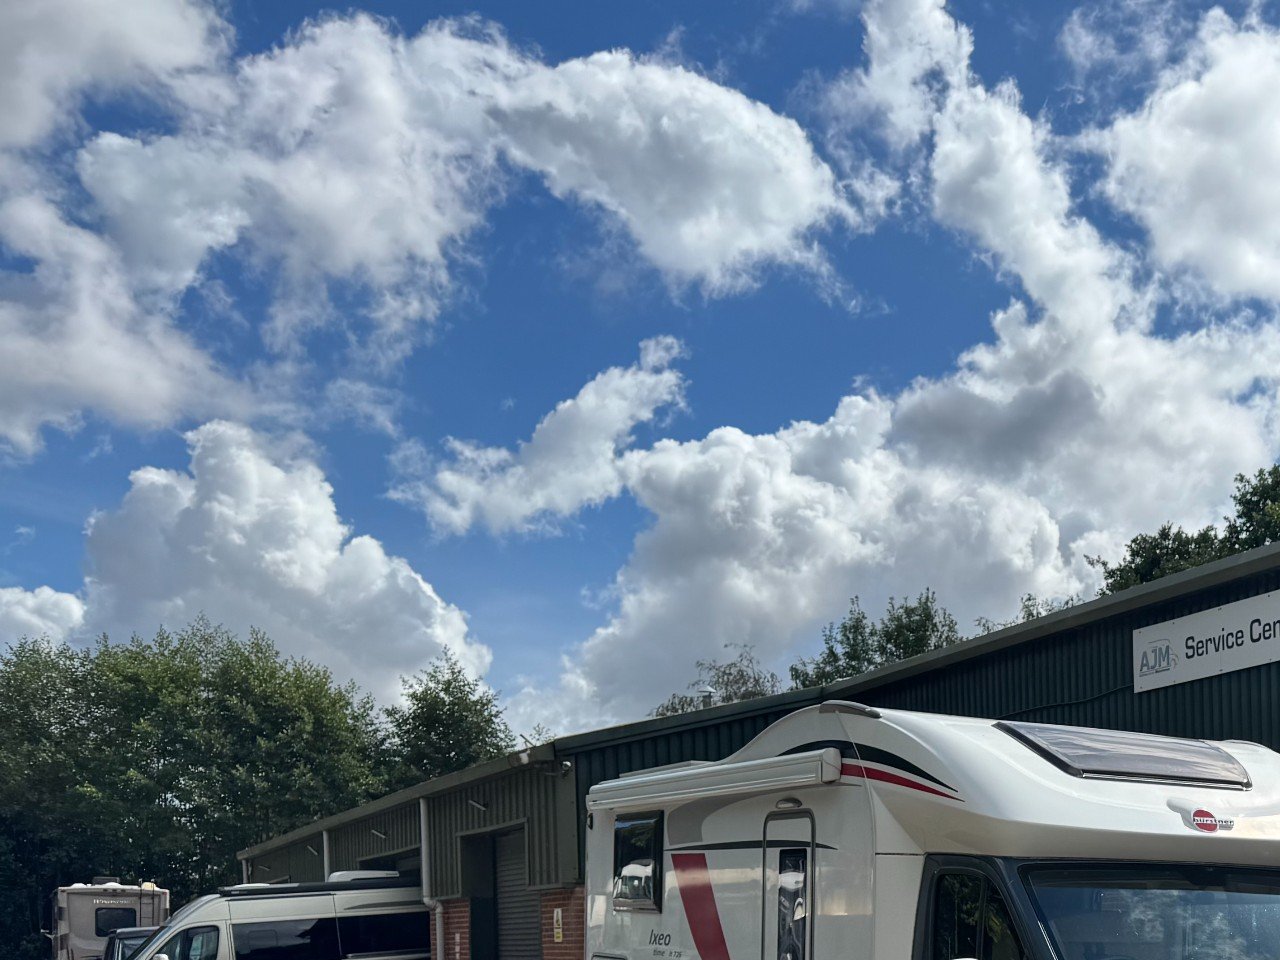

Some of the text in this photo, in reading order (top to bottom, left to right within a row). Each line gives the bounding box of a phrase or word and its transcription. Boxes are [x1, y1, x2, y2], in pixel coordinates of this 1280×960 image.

[1185, 628, 1244, 659] Service
[1139, 644, 1170, 671] AJM
[649, 929, 671, 946] Ixeo
